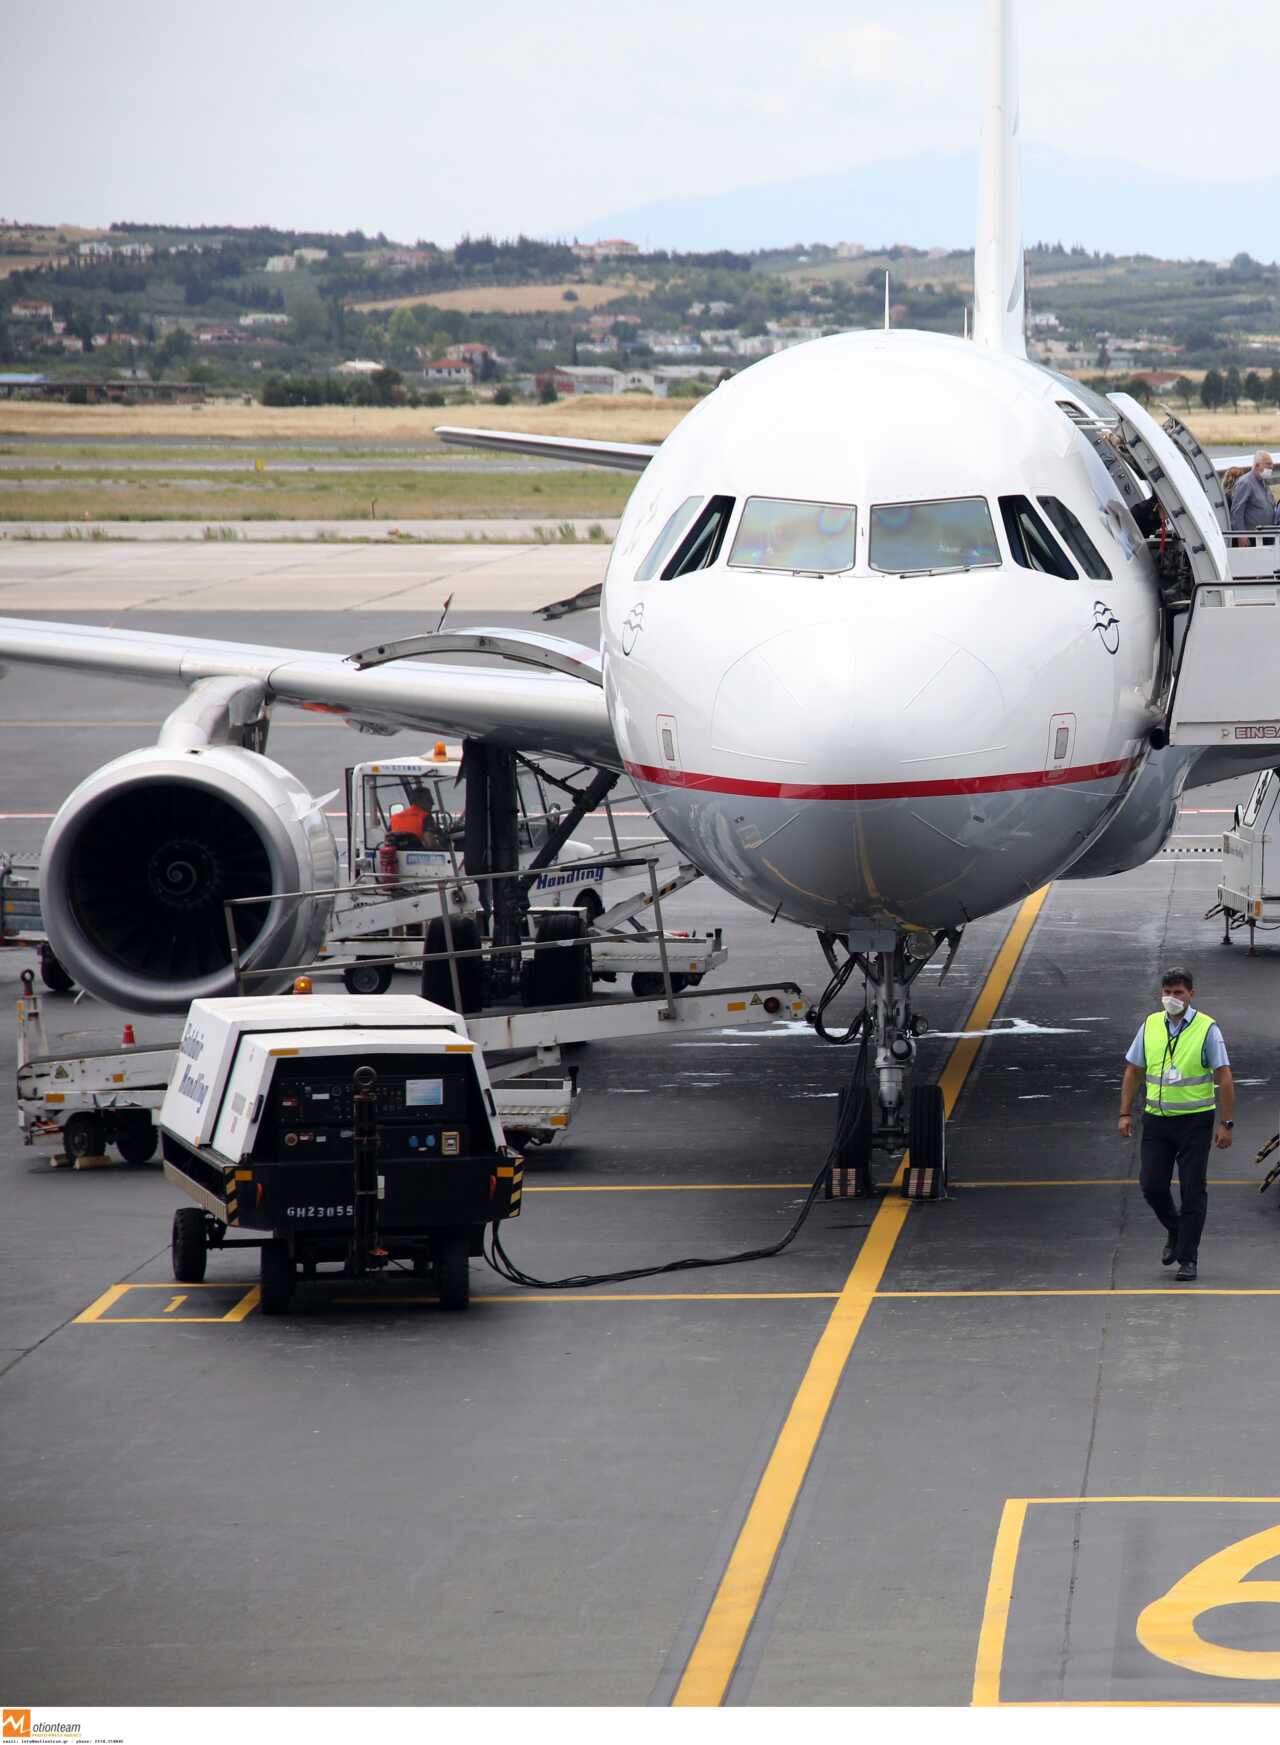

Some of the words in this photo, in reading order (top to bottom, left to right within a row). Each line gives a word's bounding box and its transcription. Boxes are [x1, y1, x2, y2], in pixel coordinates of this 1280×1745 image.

[535, 867, 605, 890] Handling
[286, 1204, 355, 1219] GH23055
[162, 1295, 188, 1313] 1
